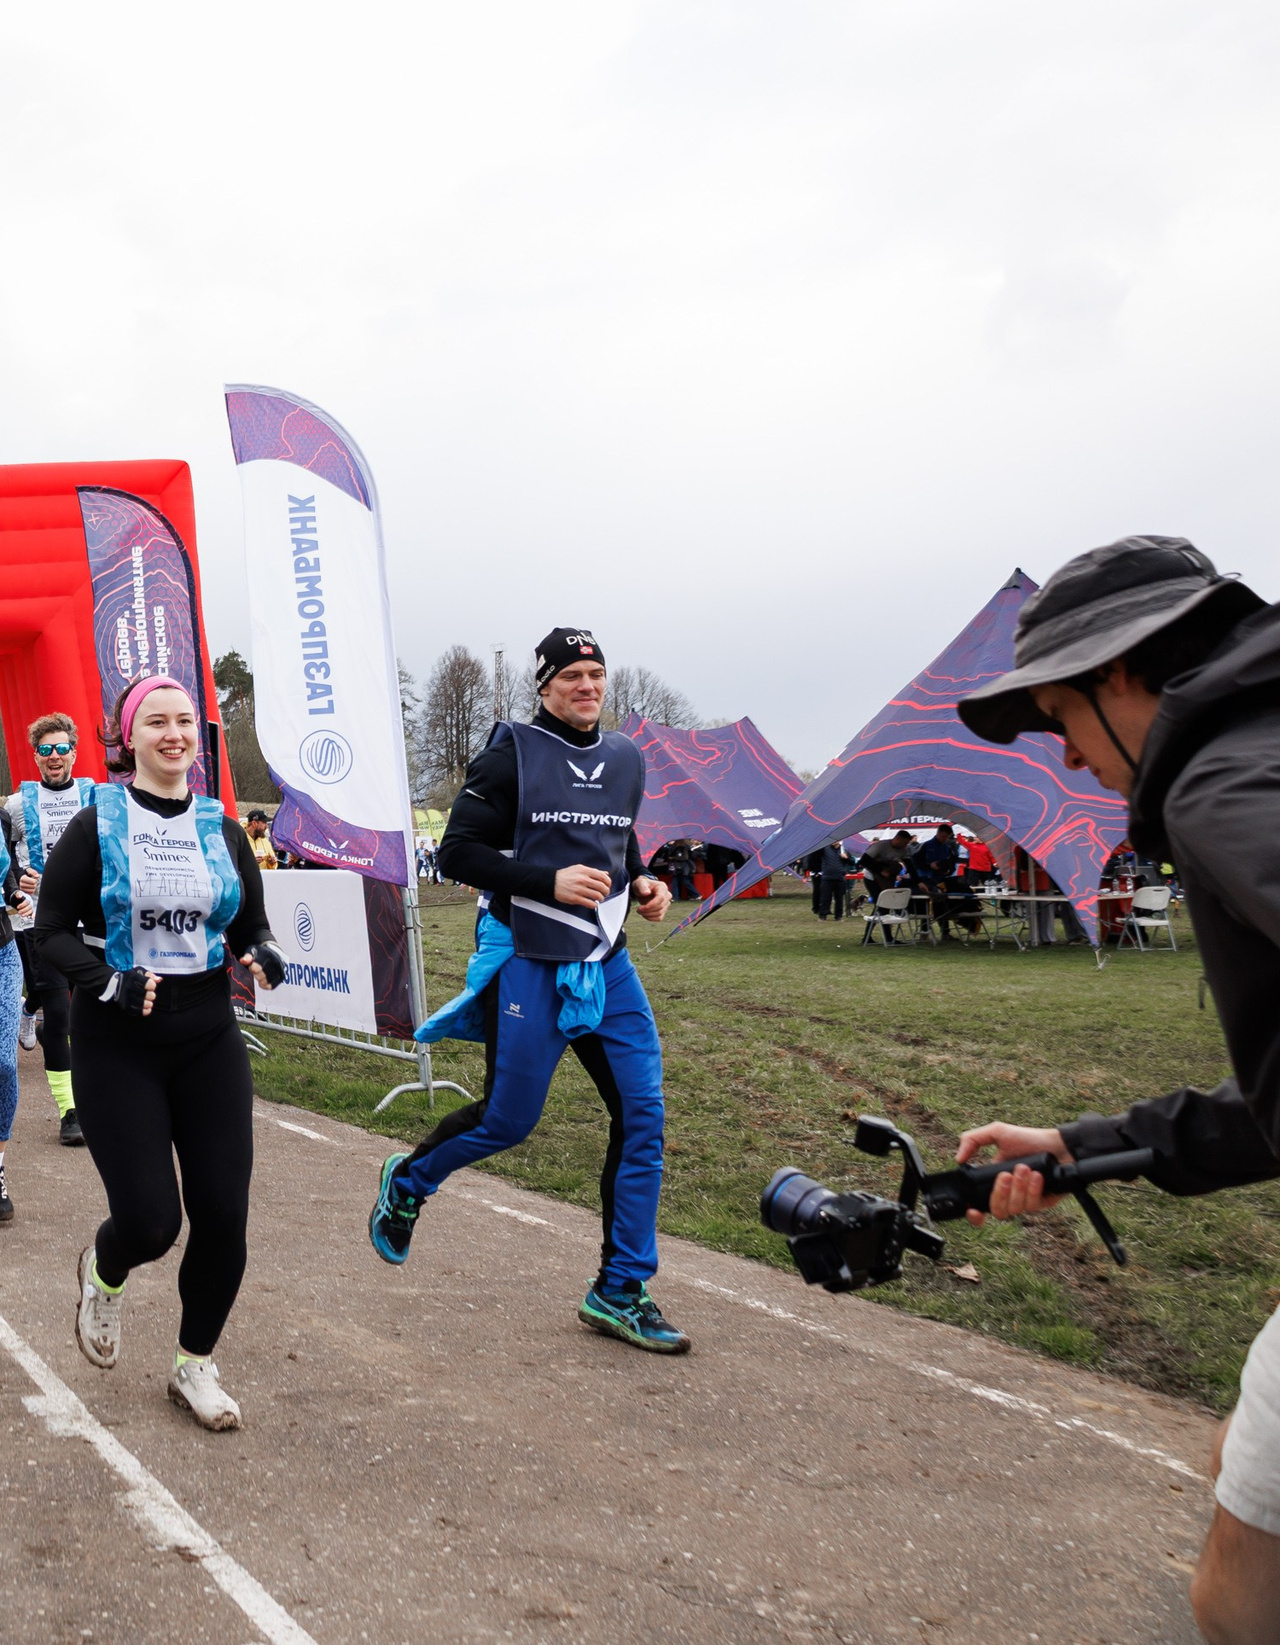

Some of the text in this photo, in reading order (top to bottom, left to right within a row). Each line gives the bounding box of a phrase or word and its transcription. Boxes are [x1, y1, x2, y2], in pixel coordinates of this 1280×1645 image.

[531, 811, 632, 828] ИНСТРУКТОР
[133, 833, 197, 848] ГОНКА ГЕРОЕВ
[143, 847, 191, 863] Sminex
[140, 909, 202, 935] 5403
[281, 963, 351, 994] ЗПРОМБАНК
